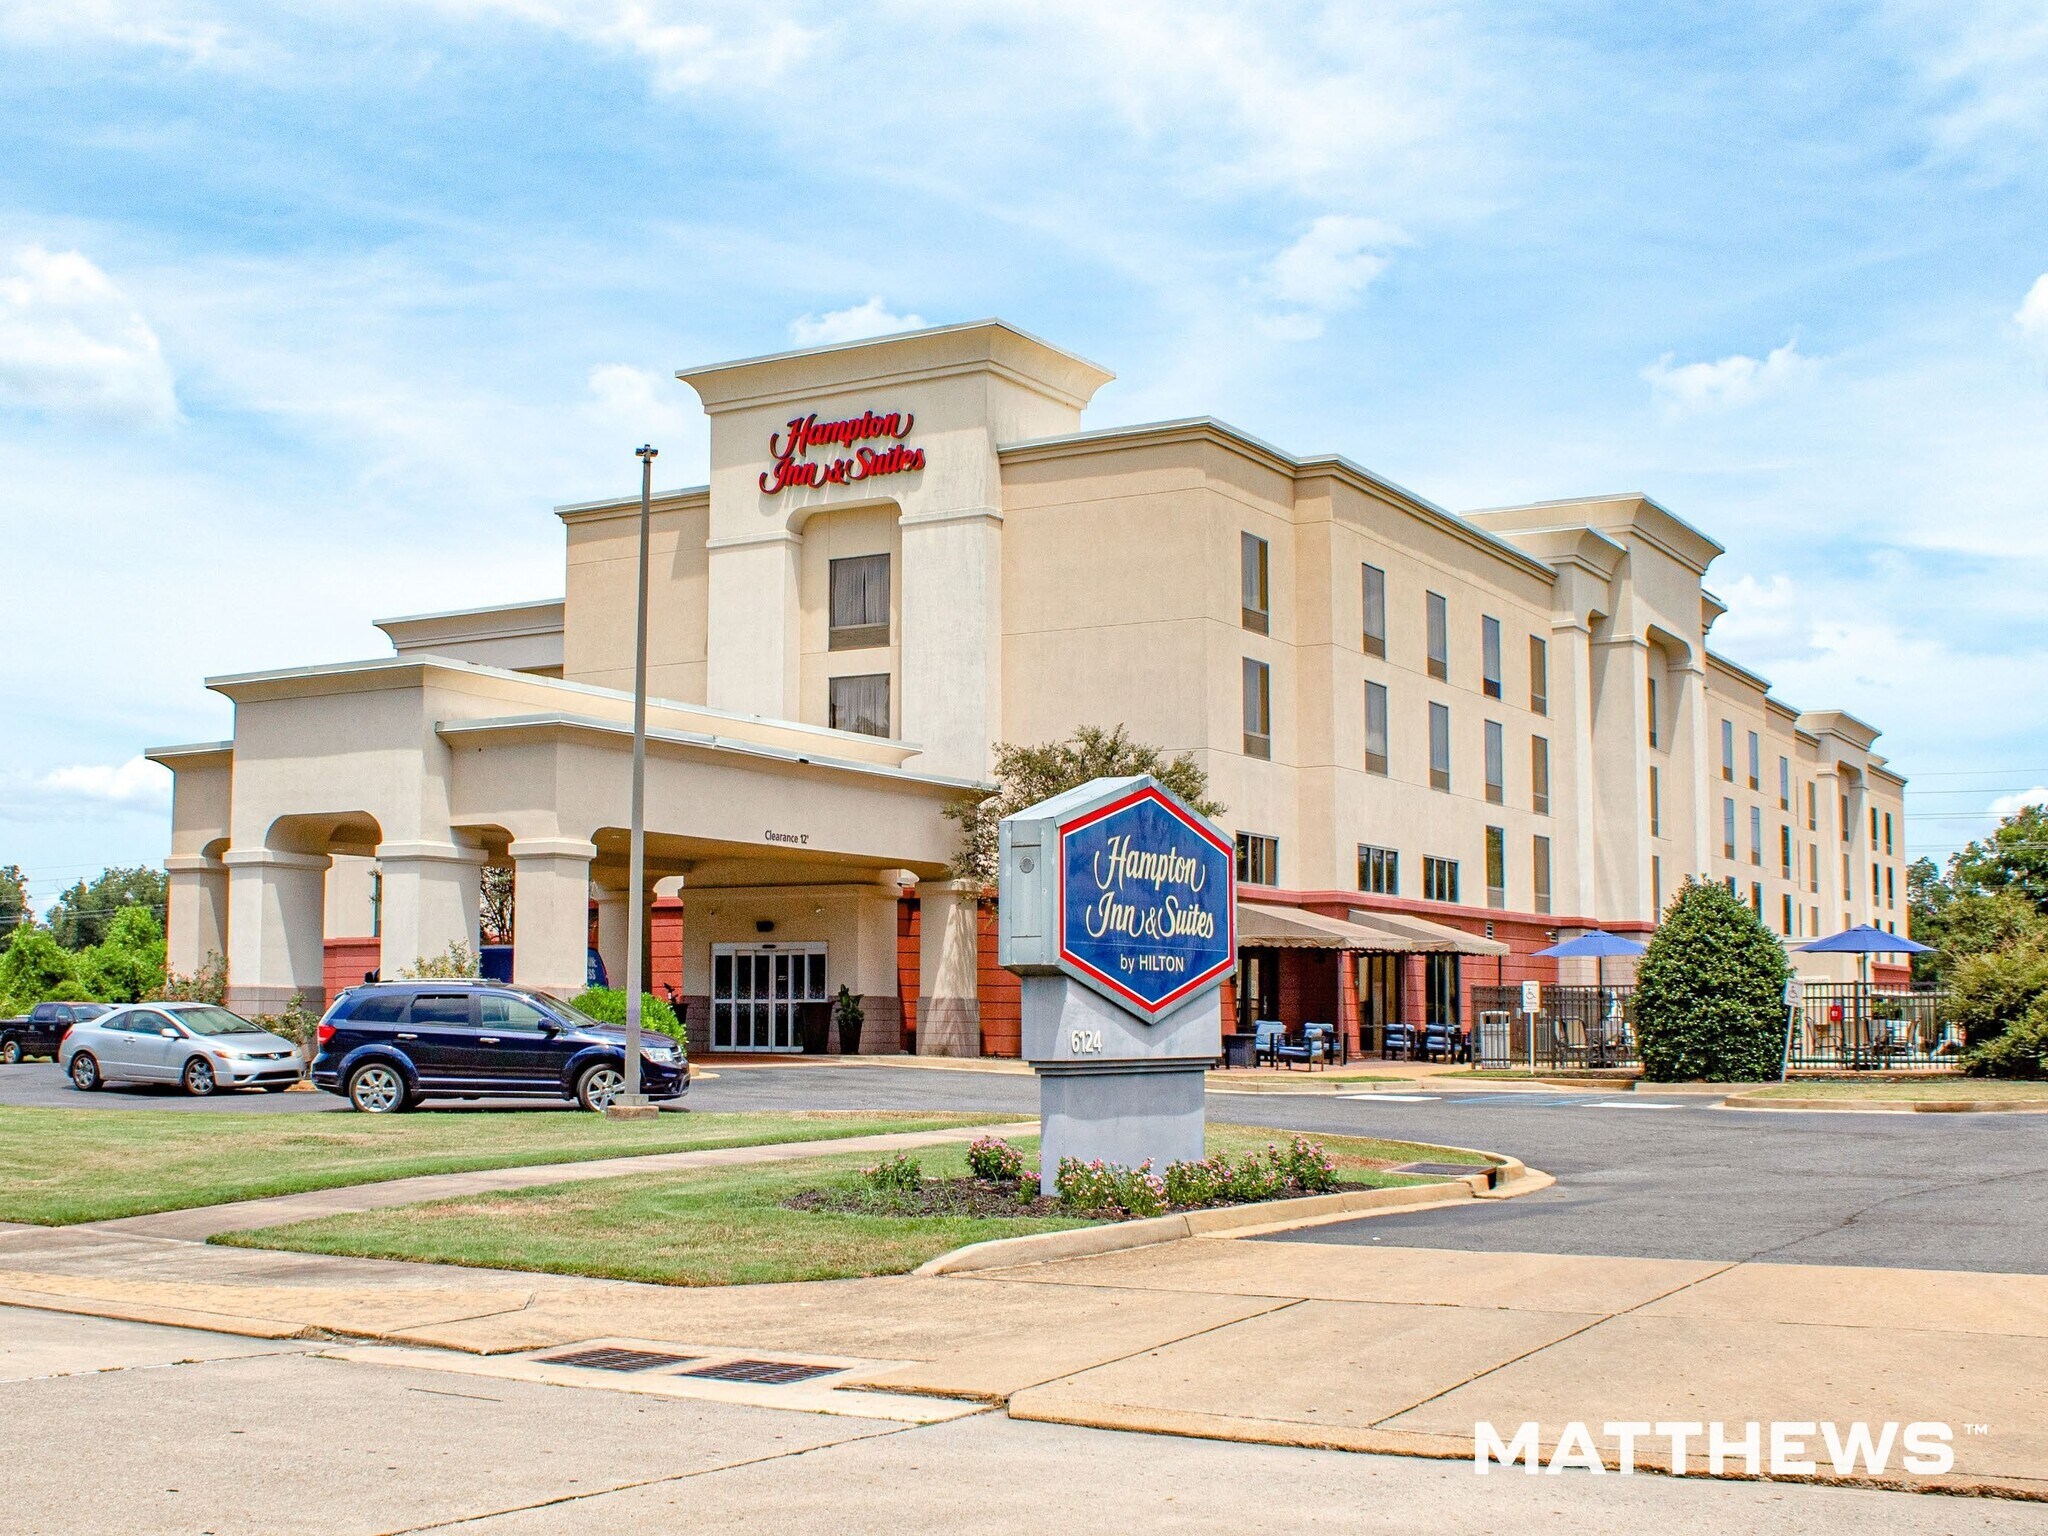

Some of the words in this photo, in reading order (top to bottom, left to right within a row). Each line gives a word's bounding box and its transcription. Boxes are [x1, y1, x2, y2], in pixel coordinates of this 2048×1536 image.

[769, 410, 914, 459] Hampton
[758, 457, 829, 494] Inn
[828, 458, 850, 485] &
[845, 444, 926, 480] Suites
[764, 830, 798, 843] Clearance
[1094, 834, 1205, 892] Hampton
[1086, 891, 1145, 938] Inn
[1144, 906, 1160, 940] &
[1158, 895, 1214, 939] Suites
[1120, 953, 1135, 974] by
[1139, 954, 1184, 972] HILTON
[1071, 1030, 1103, 1053] 6124
